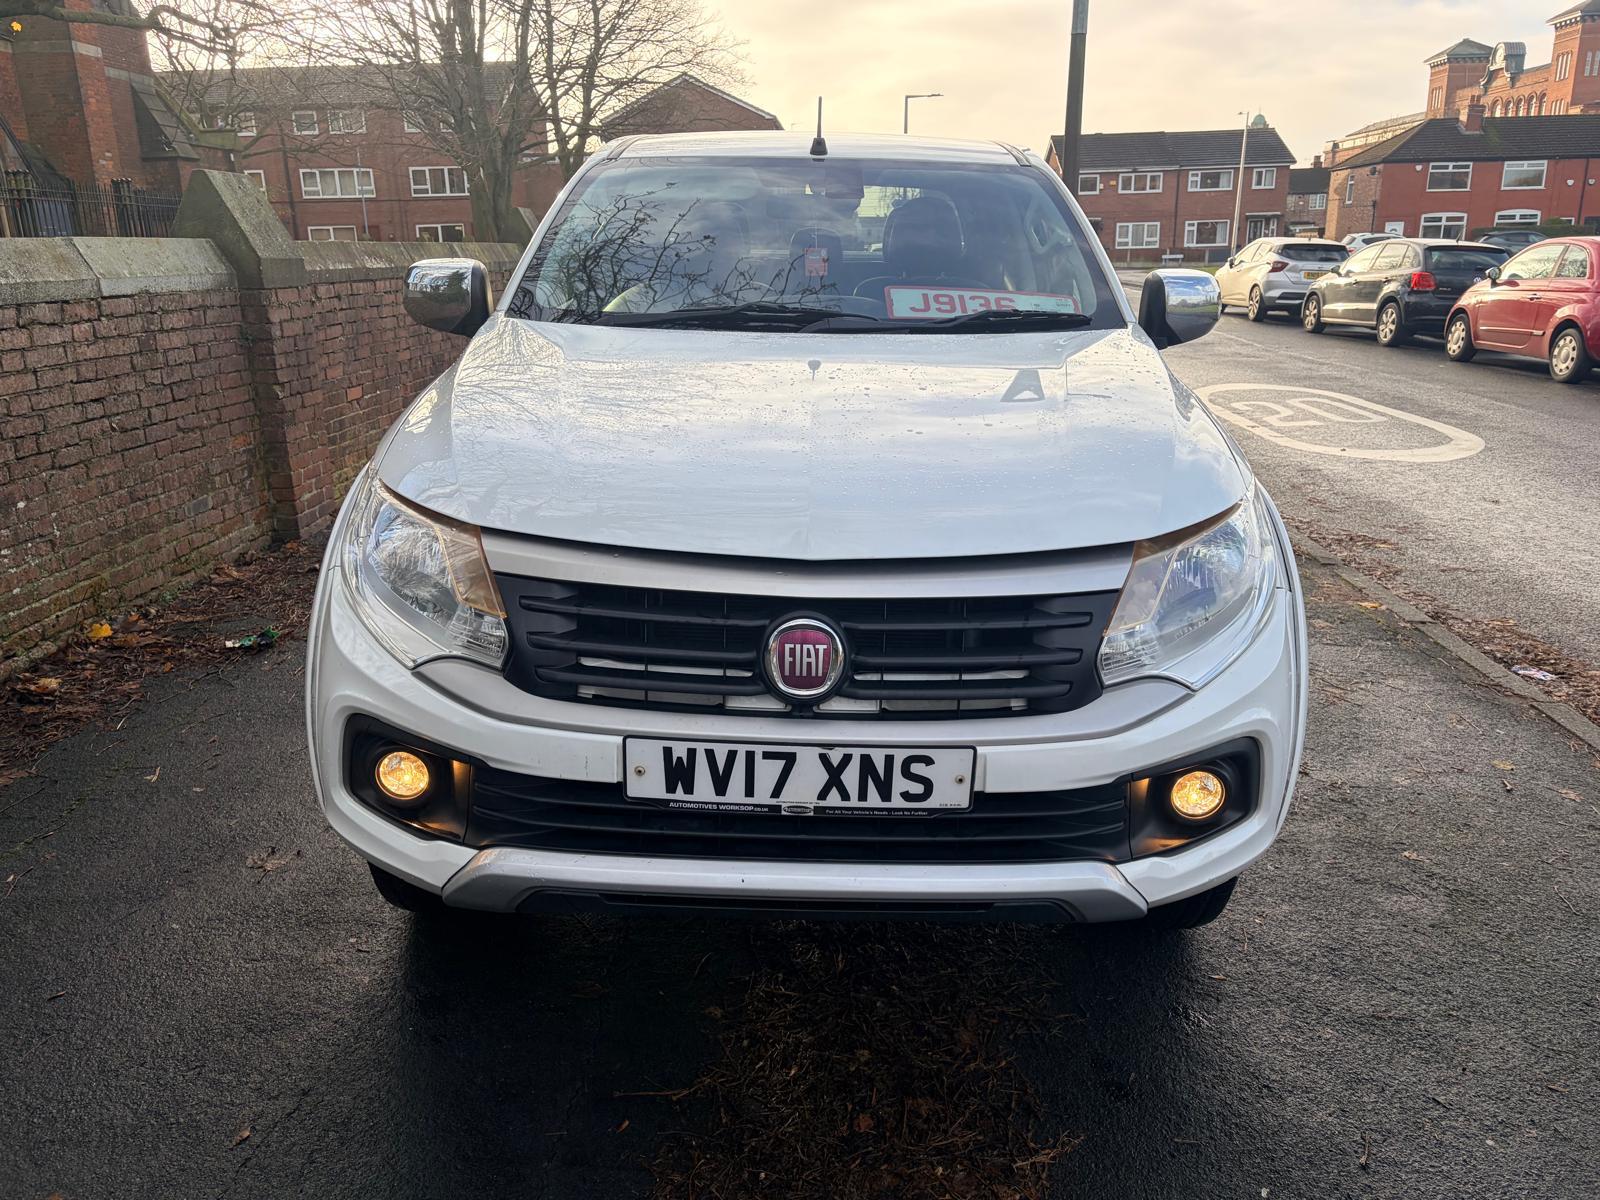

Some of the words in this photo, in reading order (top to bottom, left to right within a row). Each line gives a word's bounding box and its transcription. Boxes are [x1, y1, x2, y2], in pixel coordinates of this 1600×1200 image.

[1230, 397, 1387, 427] 20
[784, 643, 828, 677] FIAT
[662, 745, 798, 799] WV17
[816, 752, 936, 803] XNS
[669, 802, 718, 810] AUTOMOTIVES
